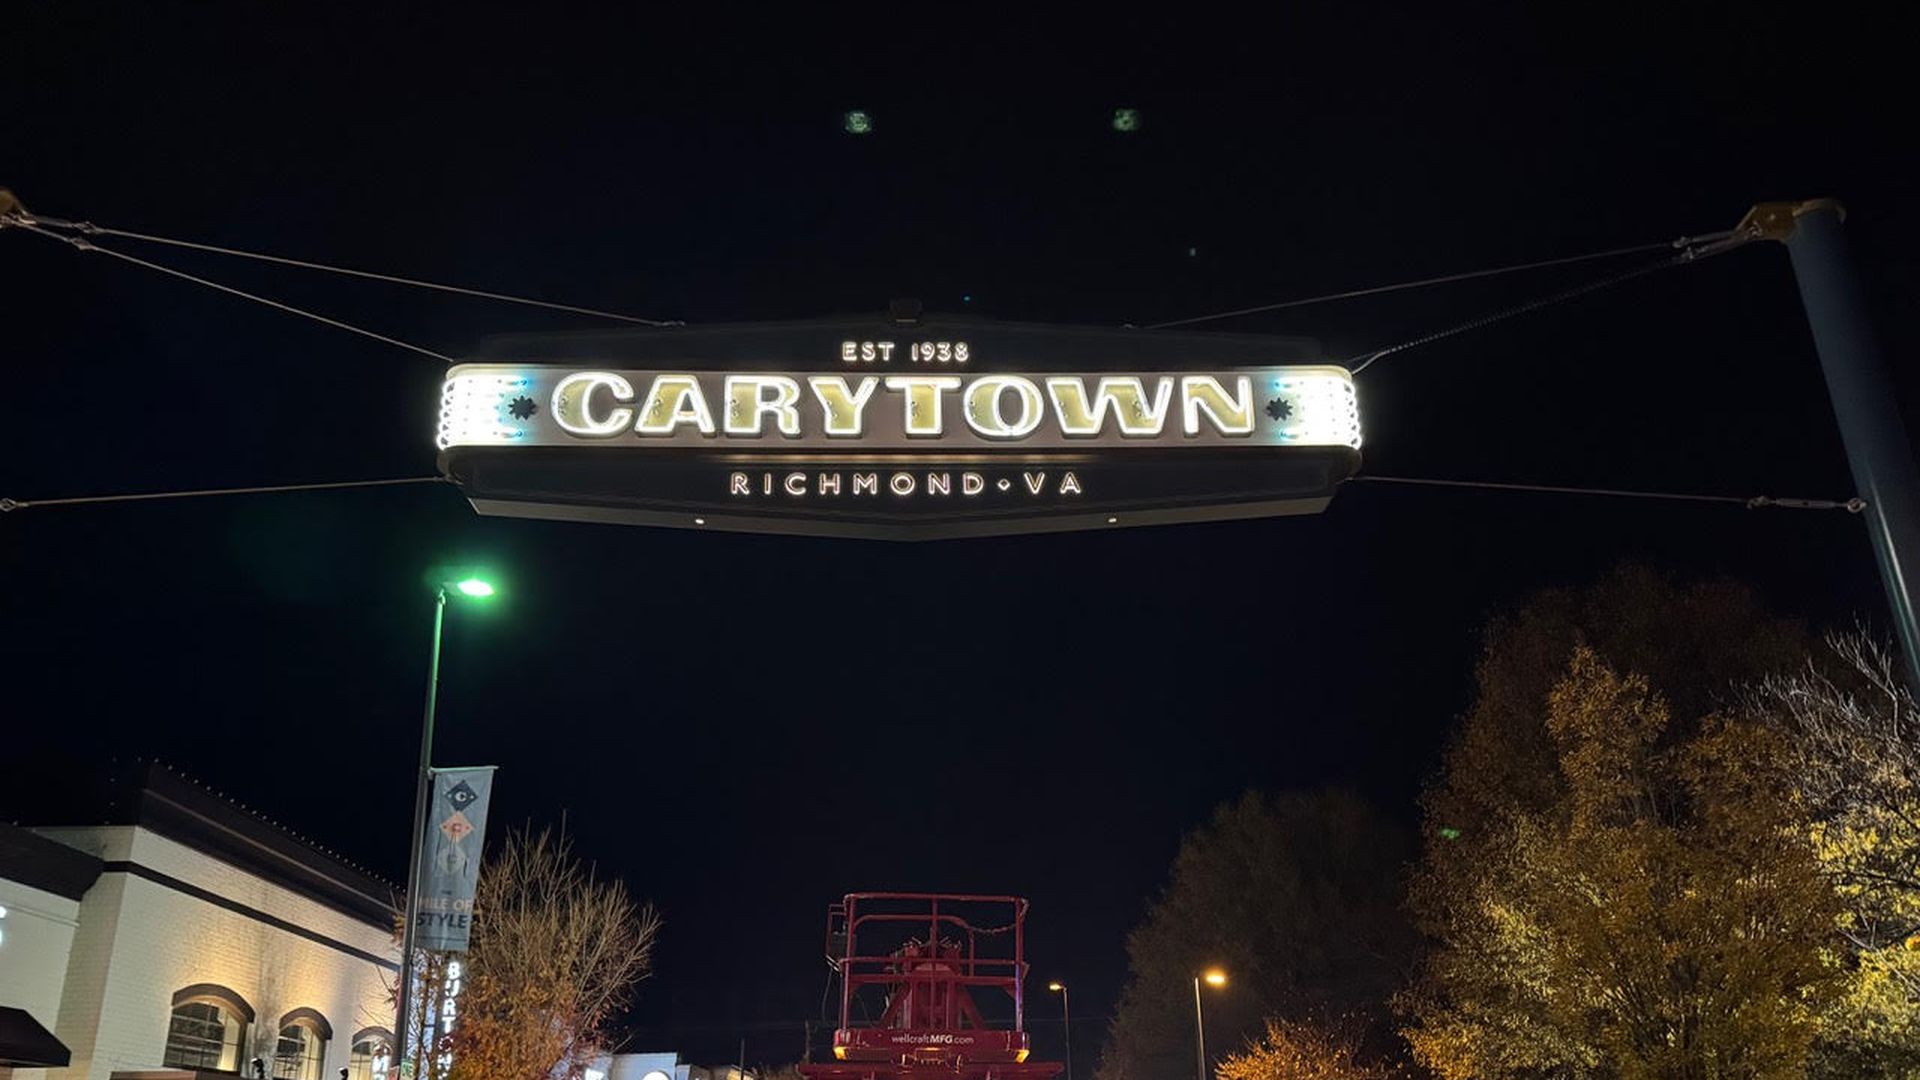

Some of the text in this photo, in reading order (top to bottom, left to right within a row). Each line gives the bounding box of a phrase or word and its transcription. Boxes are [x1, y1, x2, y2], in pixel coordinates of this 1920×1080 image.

[842, 341, 969, 362] EST 1938
[551, 371, 1256, 439] CARYTOWN
[730, 471, 1082, 495] RICHMOND VA
[416, 911, 468, 929] STYLE
[891, 1033, 975, 1045] wellcraftMFG.com
